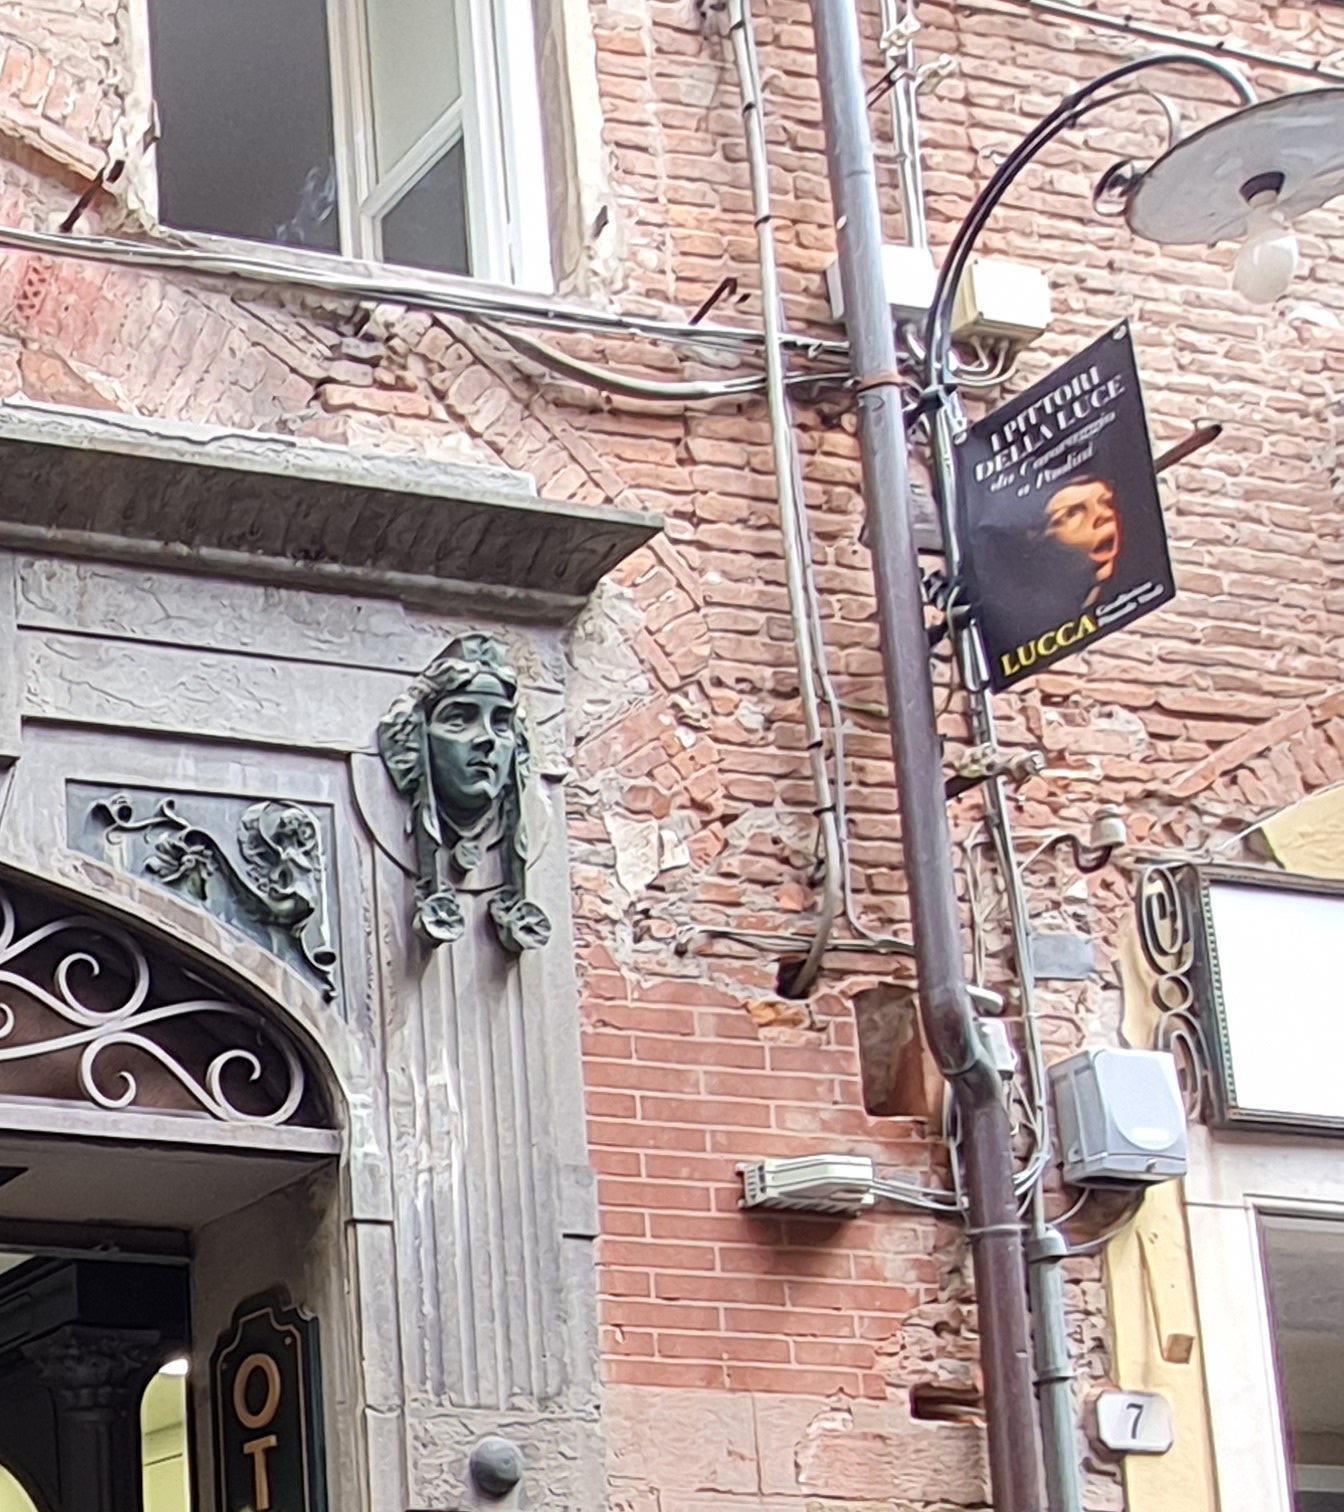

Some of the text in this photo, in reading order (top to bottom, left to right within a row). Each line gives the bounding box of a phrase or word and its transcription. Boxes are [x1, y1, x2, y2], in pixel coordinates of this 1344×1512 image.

[975, 374, 1126, 482] DELLA LUCE
[1002, 366, 1100, 443] PITTORI
[1000, 614, 1098, 677] LUCCA
[1125, 1403, 1144, 1440] 7
